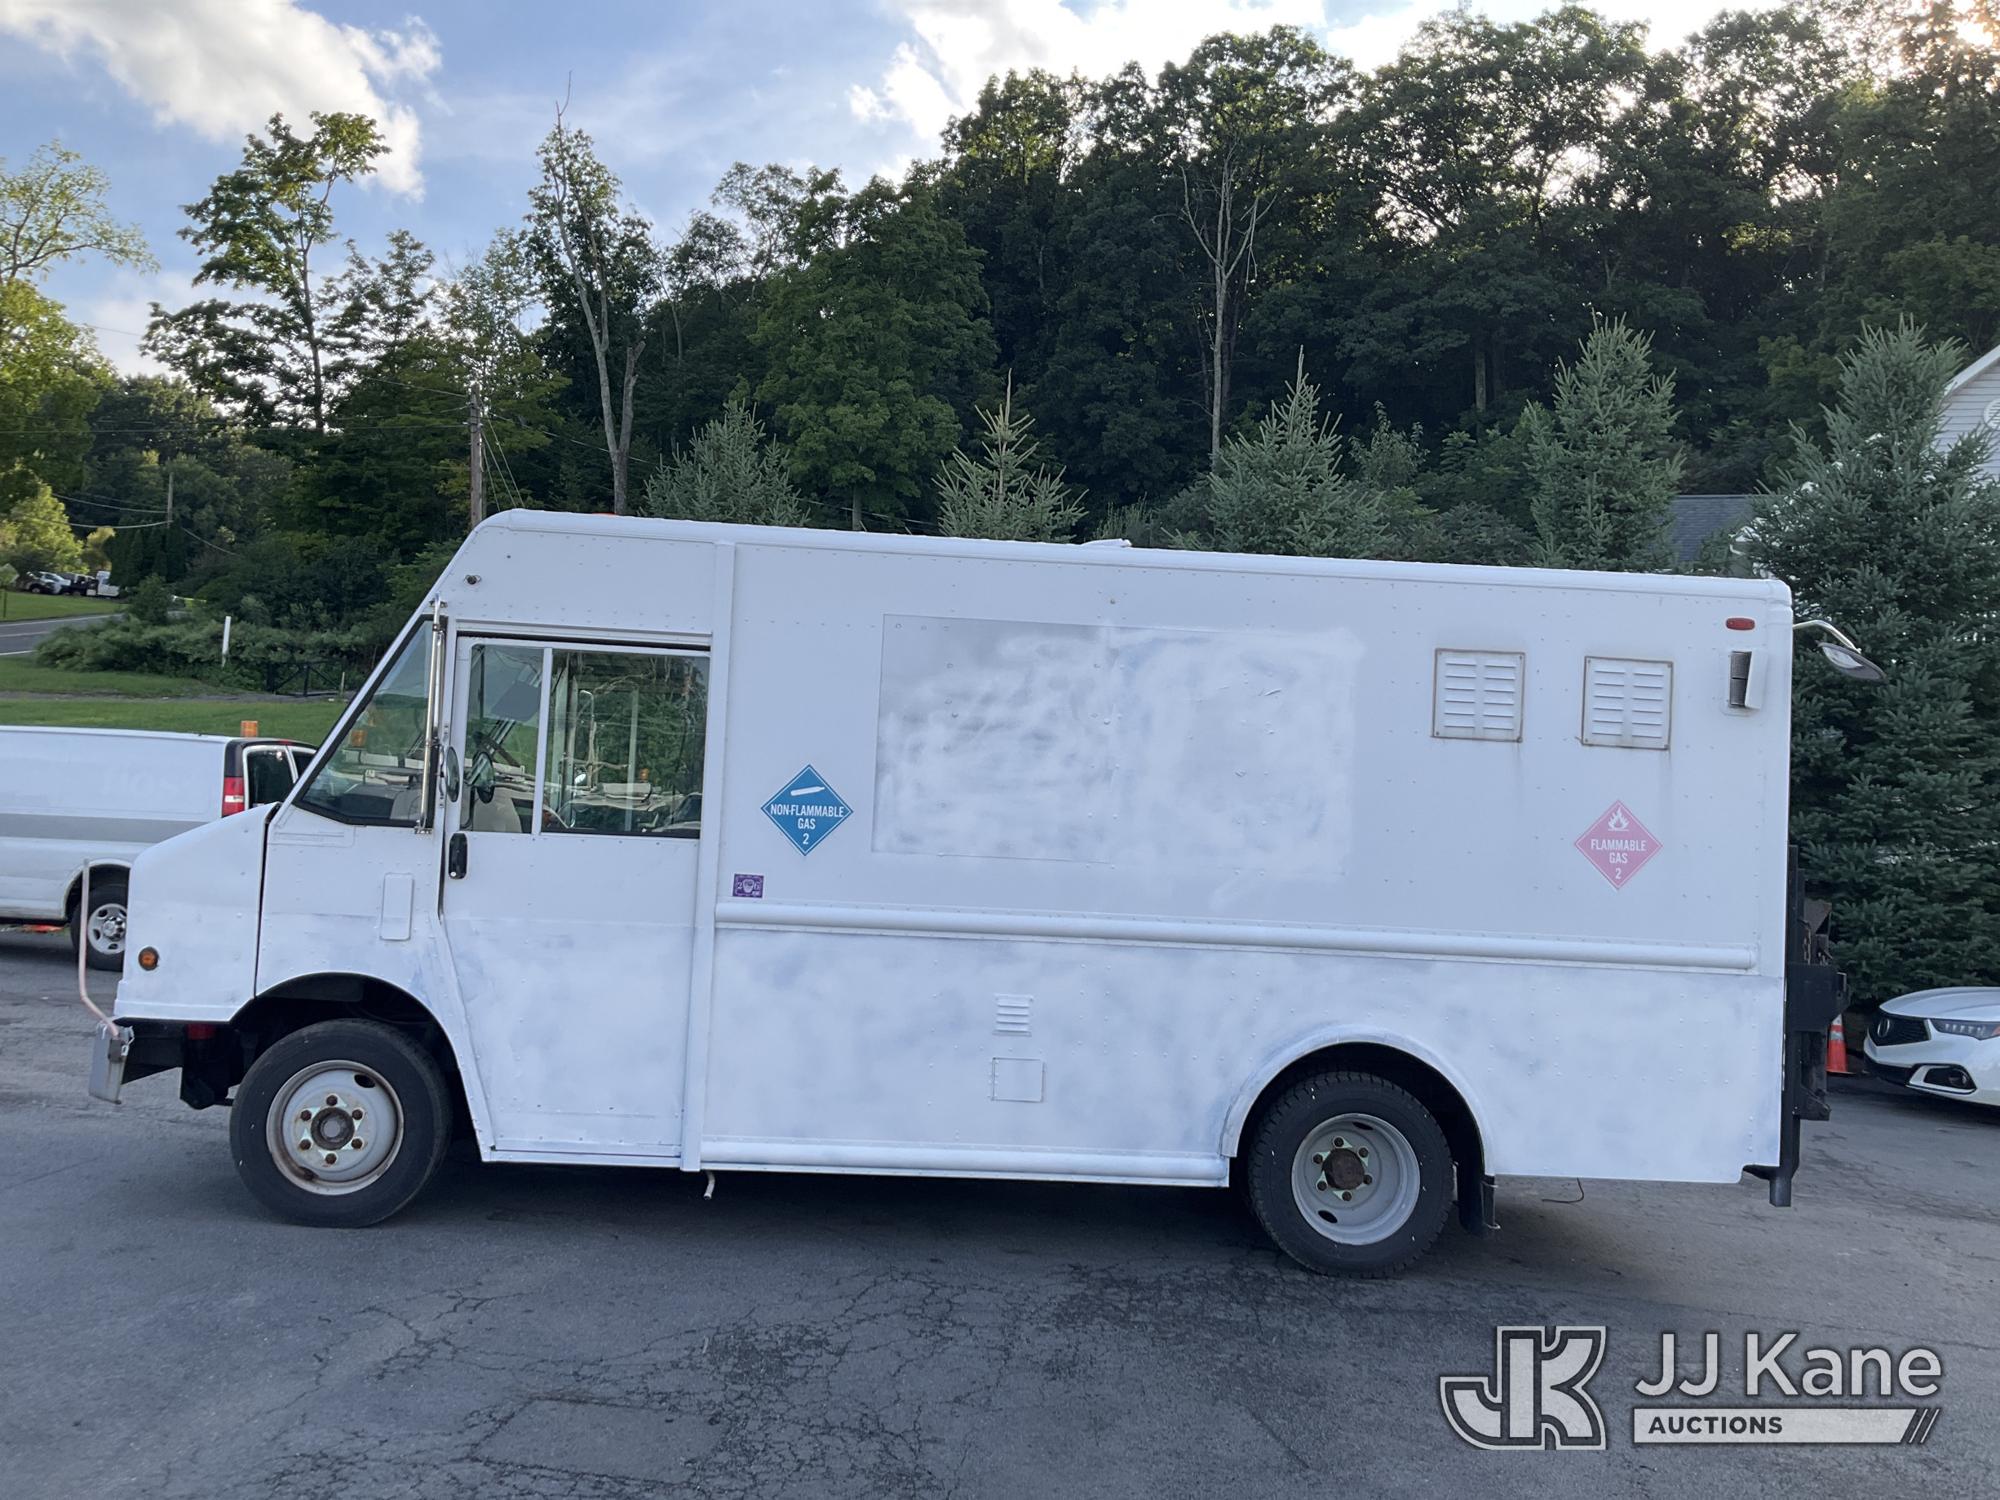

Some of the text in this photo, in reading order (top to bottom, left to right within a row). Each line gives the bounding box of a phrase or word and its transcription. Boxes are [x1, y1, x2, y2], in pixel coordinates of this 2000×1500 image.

[770, 804, 844, 817] NON-FLAMMABLE
[797, 818, 816, 830] GAS
[803, 833, 809, 844] 2
[1590, 839, 1647, 851] FLAMMABLE
[1609, 852, 1628, 864] GAS
[1615, 867, 1621, 879] 2
